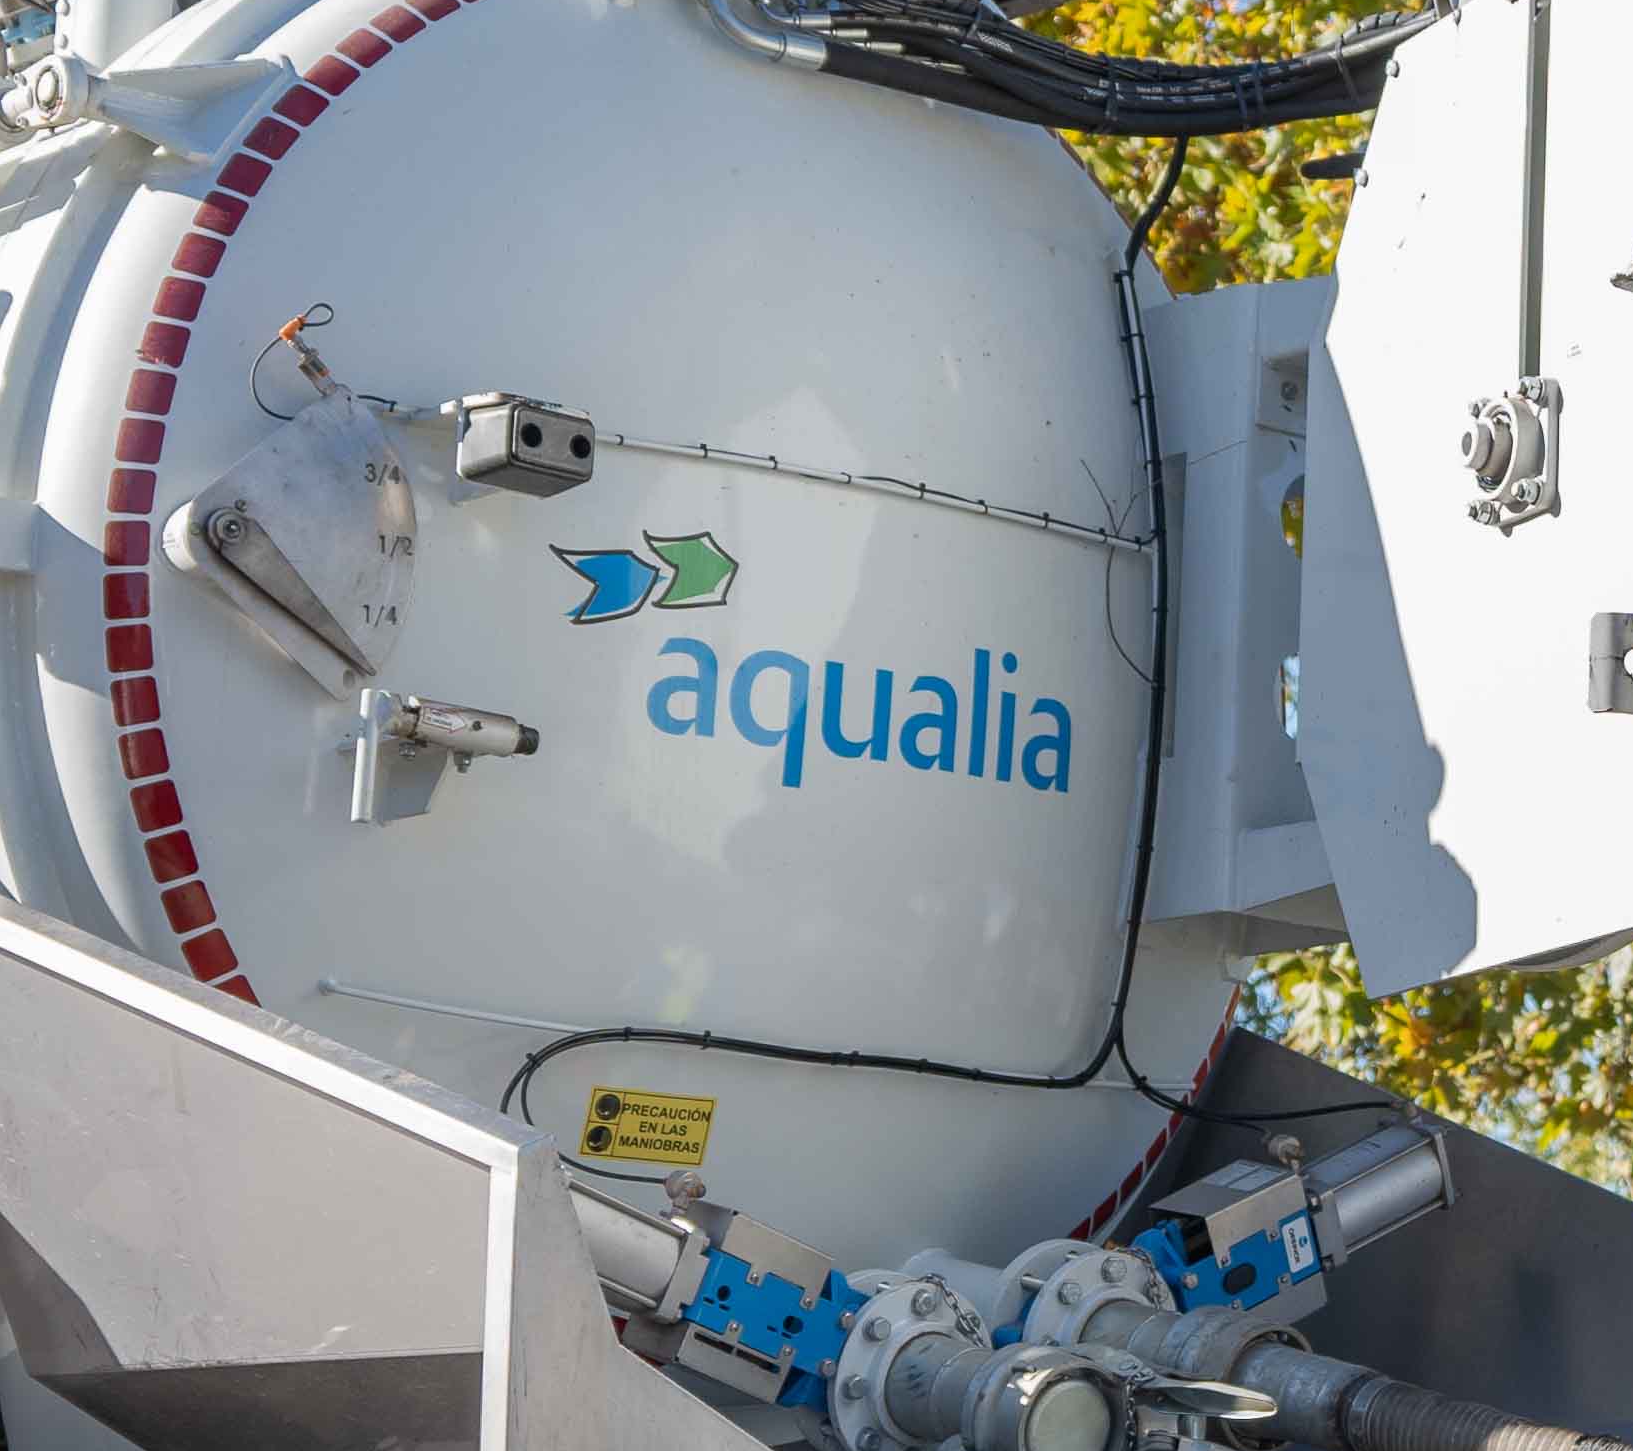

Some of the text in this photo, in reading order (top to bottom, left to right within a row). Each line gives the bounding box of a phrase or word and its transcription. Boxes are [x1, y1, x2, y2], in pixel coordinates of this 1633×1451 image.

[364, 462, 401, 485] 3/4
[378, 534, 413, 557] 1/2
[363, 604, 398, 627] 1/4
[646, 635, 1072, 794] aqualia
[621, 1102, 712, 1123] PRECAUCIÓN
[638, 1121, 688, 1136] EN LAS
[618, 1135, 700, 1154] MANIOBRAS
